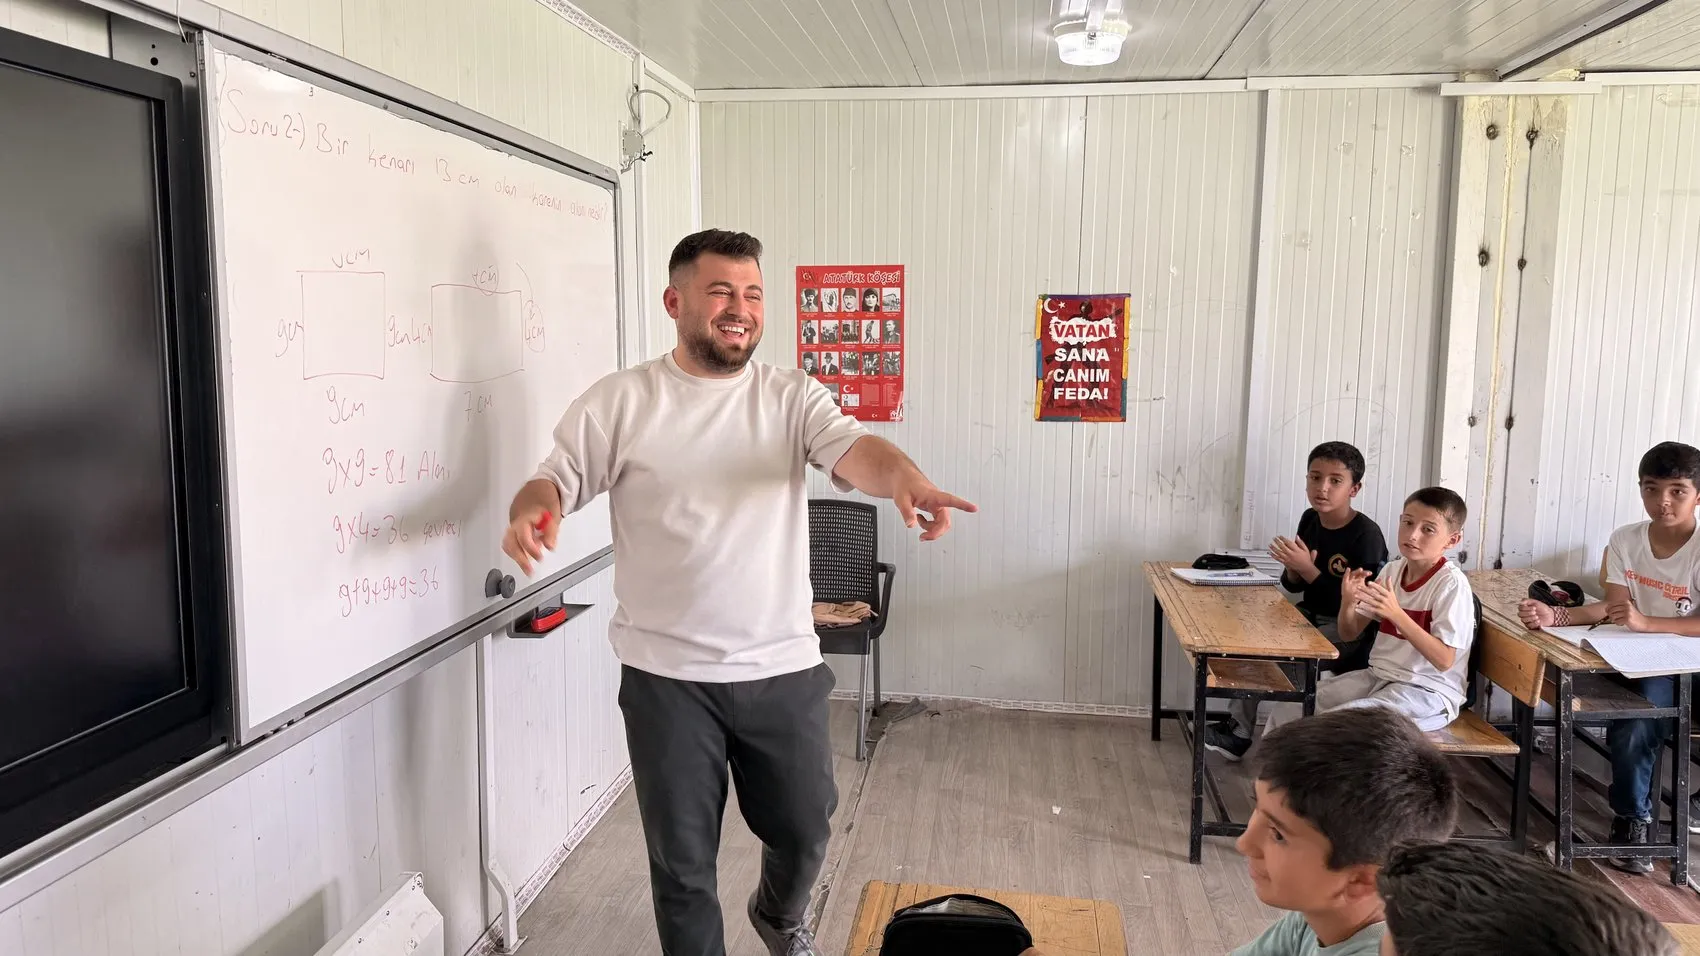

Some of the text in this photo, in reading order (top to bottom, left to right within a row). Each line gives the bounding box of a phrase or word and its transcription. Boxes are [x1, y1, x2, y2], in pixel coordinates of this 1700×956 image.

[316, 122, 349, 154] Bir
[435, 157, 452, 182] 13
[823, 270, 900, 286] ATATÜRK KÖŞESİ
[1053, 324, 1110, 338] VATAN
[1054, 348, 1110, 361] SANA
[1053, 368, 1110, 382] CANIM
[1053, 388, 1109, 400] FEDA!
[1639, 576, 1663, 590] MUSIC
